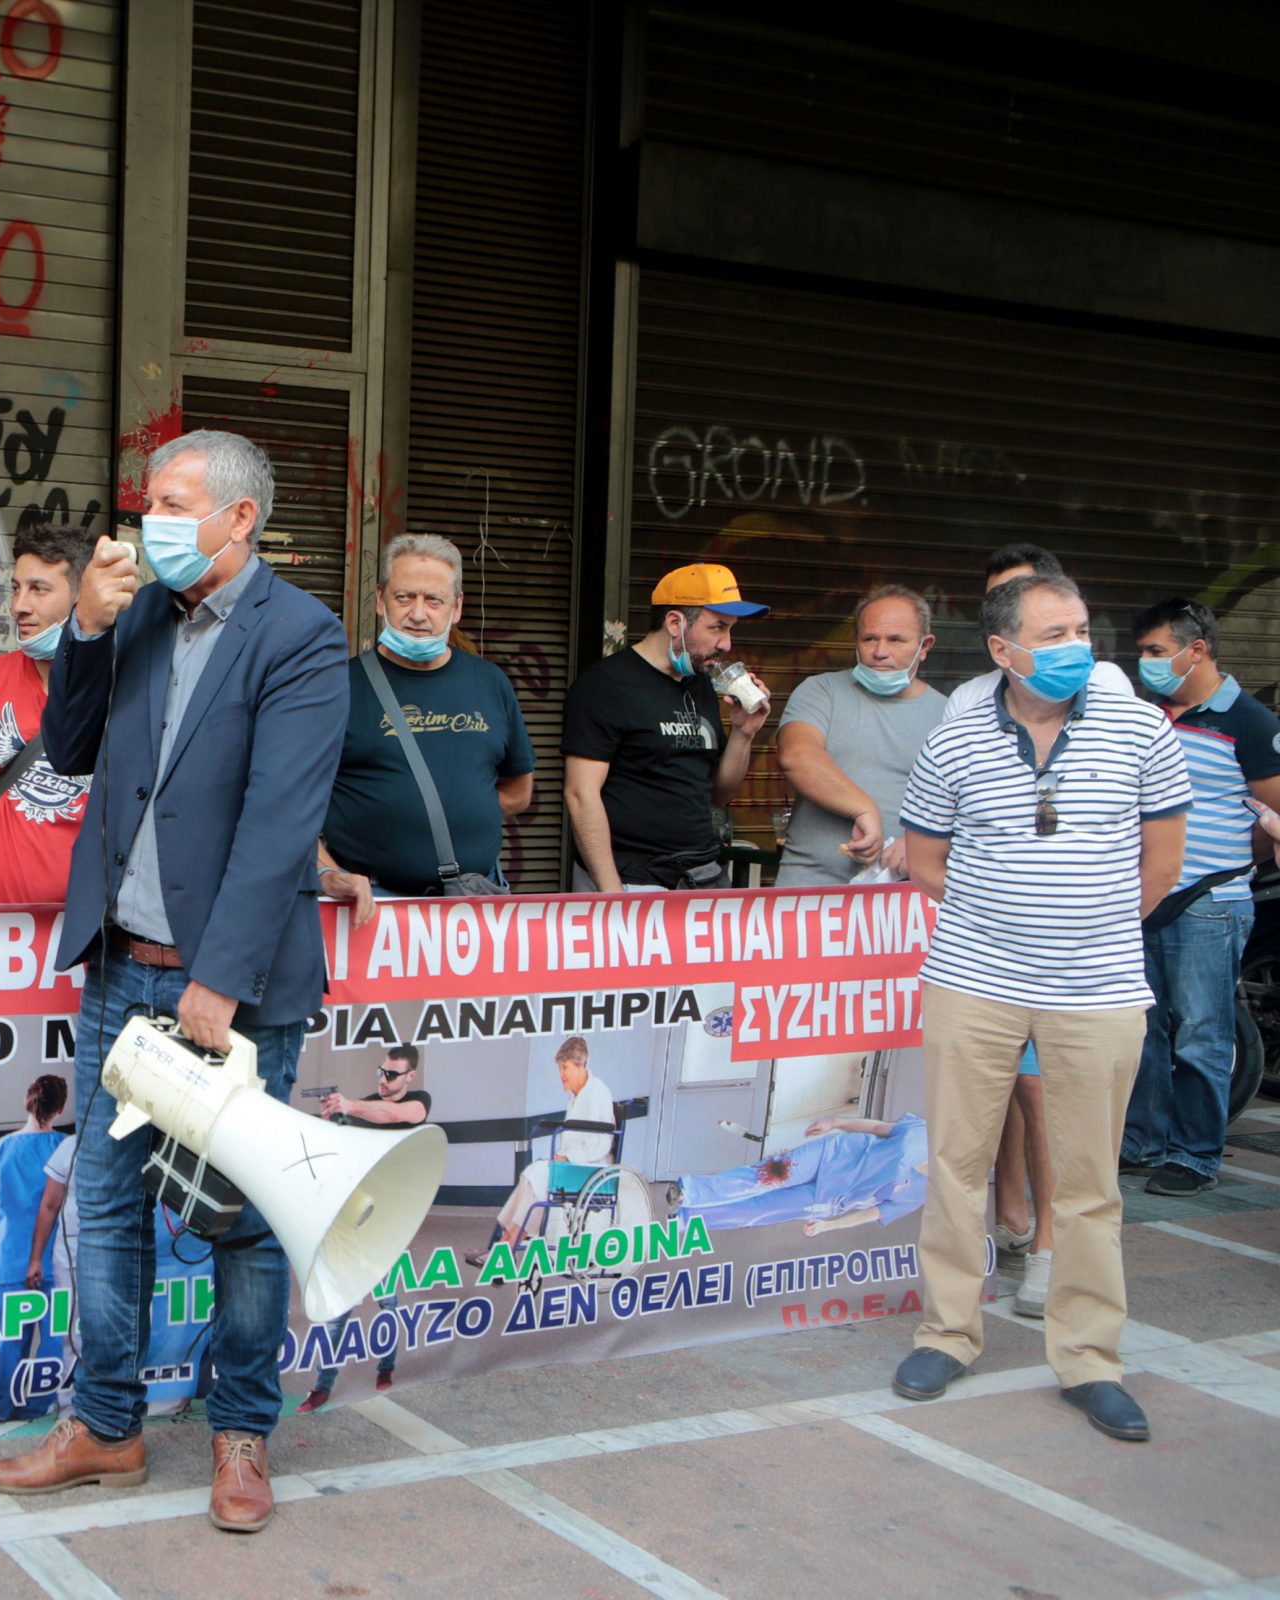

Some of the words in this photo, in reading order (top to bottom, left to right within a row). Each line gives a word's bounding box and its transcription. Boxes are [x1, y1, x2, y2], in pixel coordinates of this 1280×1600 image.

[22, 769, 78, 796] ickies
[366, 899, 673, 980] ΑΝΘΥΓΙΕΙΝΑ
[411, 985, 705, 1046] ΑΝΑΠΗΡΙΑ
[738, 977, 923, 1043] ΣΥΖΗΤΕΙΤ
[478, 1214, 715, 1287] ΑΛΗΘΙΝΑ
[500, 1280, 600, 1336] ΔΕΝ
[610, 1262, 734, 1319] ΘΕΛΕΙ
